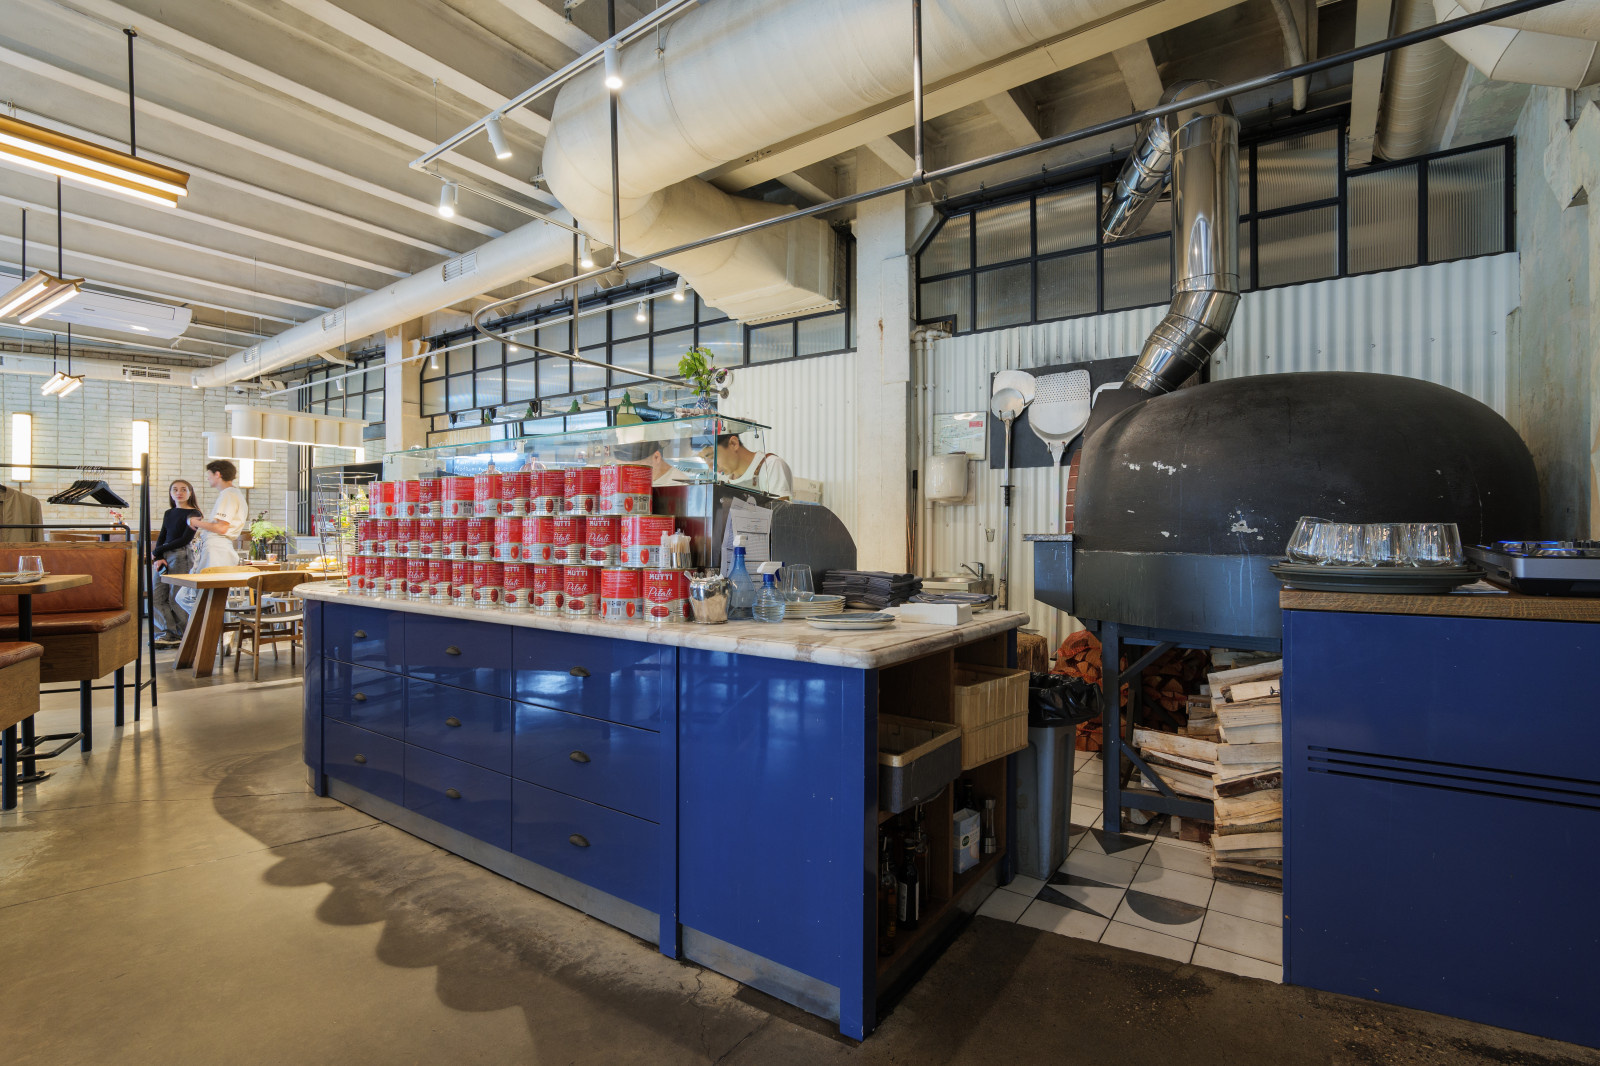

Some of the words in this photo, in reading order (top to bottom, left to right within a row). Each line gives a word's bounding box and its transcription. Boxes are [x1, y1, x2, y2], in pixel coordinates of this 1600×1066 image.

[588, 532, 611, 543] Pelati
[648, 572, 673, 581] MUTTI
[566, 581, 589, 592] Pelati
[647, 586, 674, 598] Pelati
